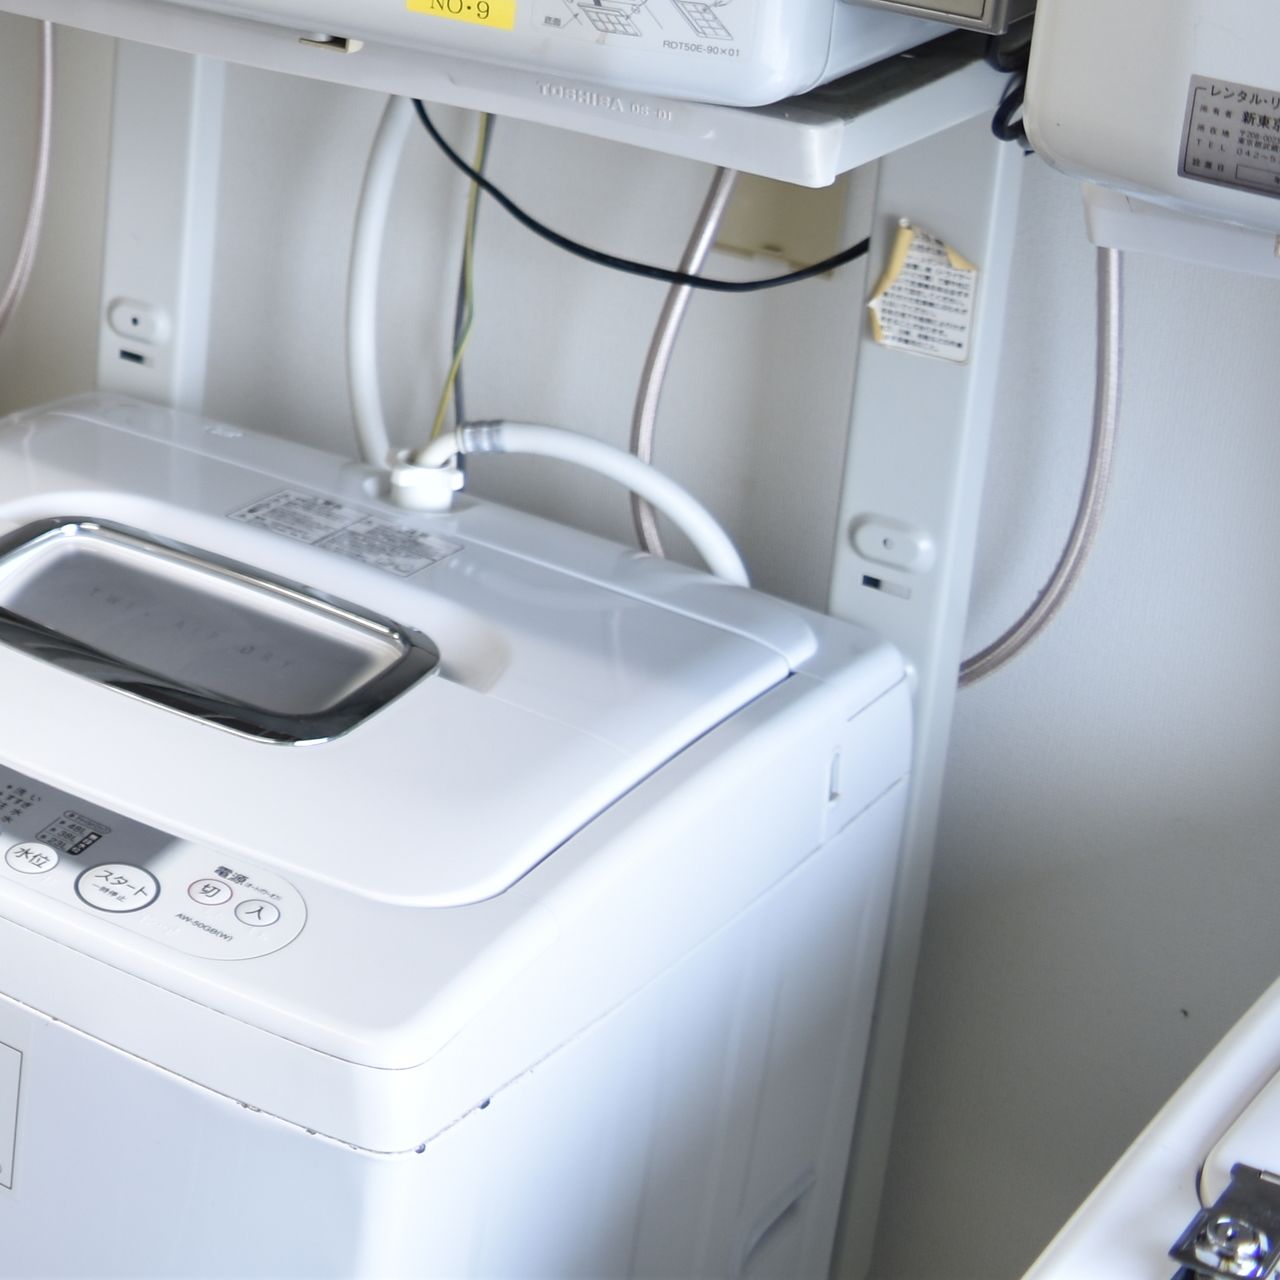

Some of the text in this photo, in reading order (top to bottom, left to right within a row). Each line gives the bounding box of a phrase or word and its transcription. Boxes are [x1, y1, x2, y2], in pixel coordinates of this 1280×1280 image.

[541, 83, 624, 112] TOSHIBA
[14, 847, 50, 868] 水位
[95, 870, 148, 897] スタート
[214, 866, 249, 885] 電源
[92, 883, 127, 903] 一時停止
[200, 883, 221, 898] 切
[245, 906, 264, 920] 入
[175, 913, 233, 942] AW-50GB(W)
